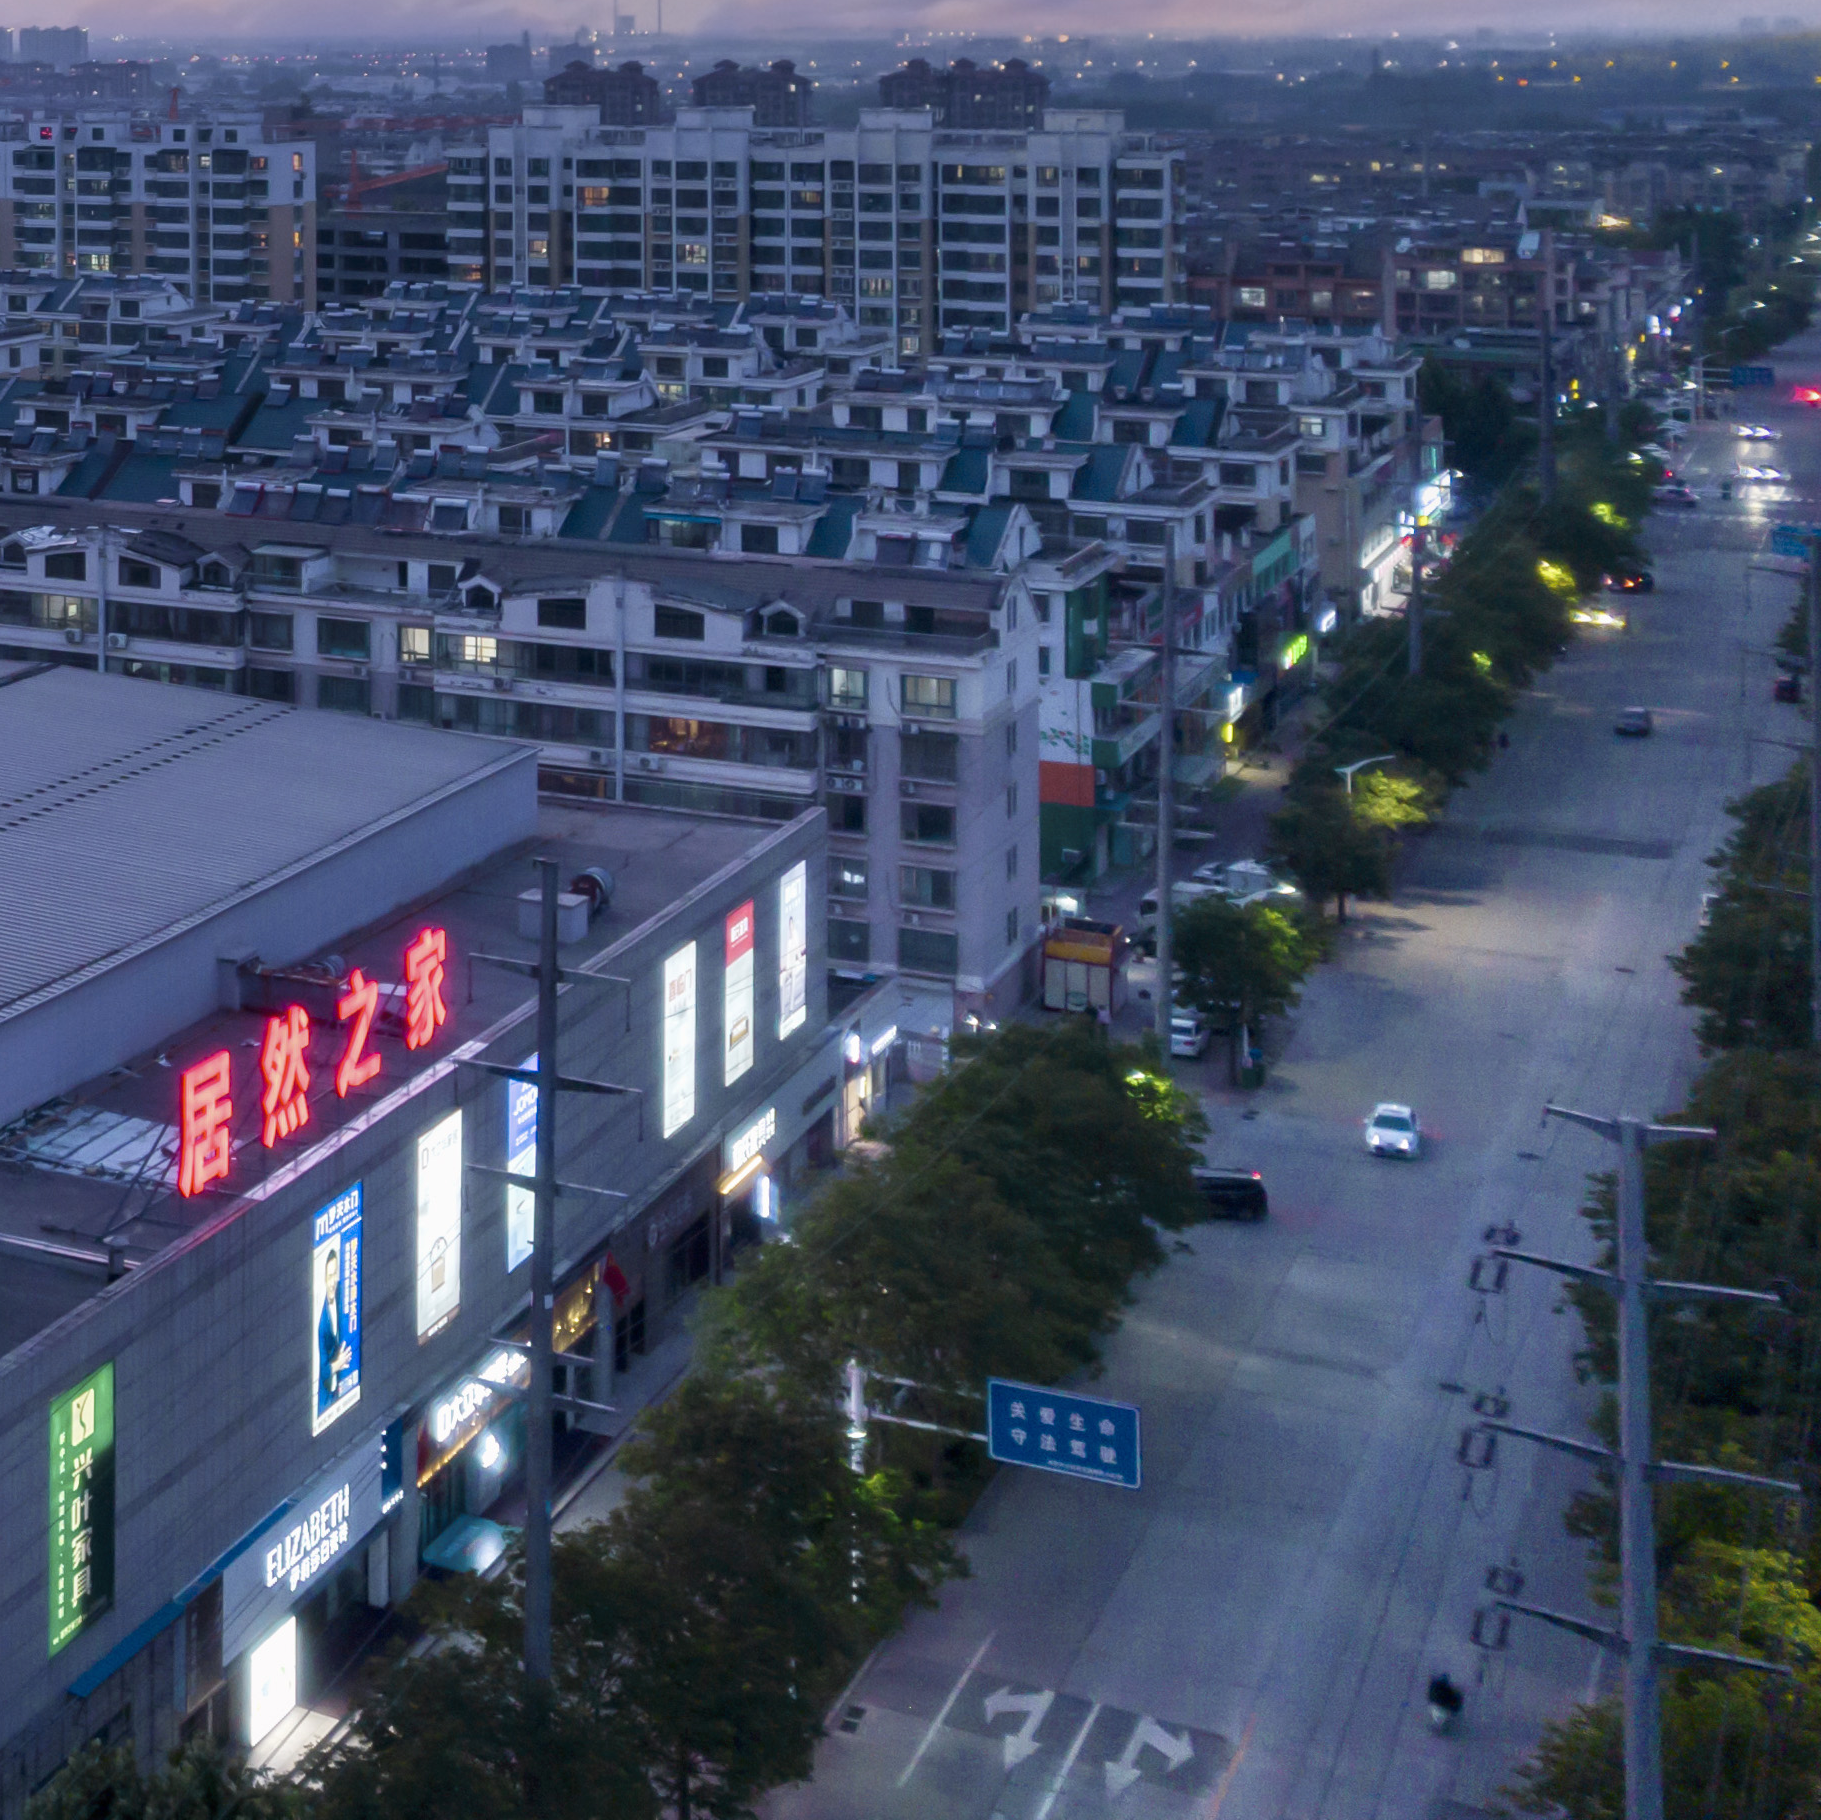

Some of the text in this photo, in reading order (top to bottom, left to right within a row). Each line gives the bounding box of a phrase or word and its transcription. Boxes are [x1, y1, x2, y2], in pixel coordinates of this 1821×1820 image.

[177, 927, 447, 1198] 居然之家
[265, 1482, 350, 1588] ELIZABETH
